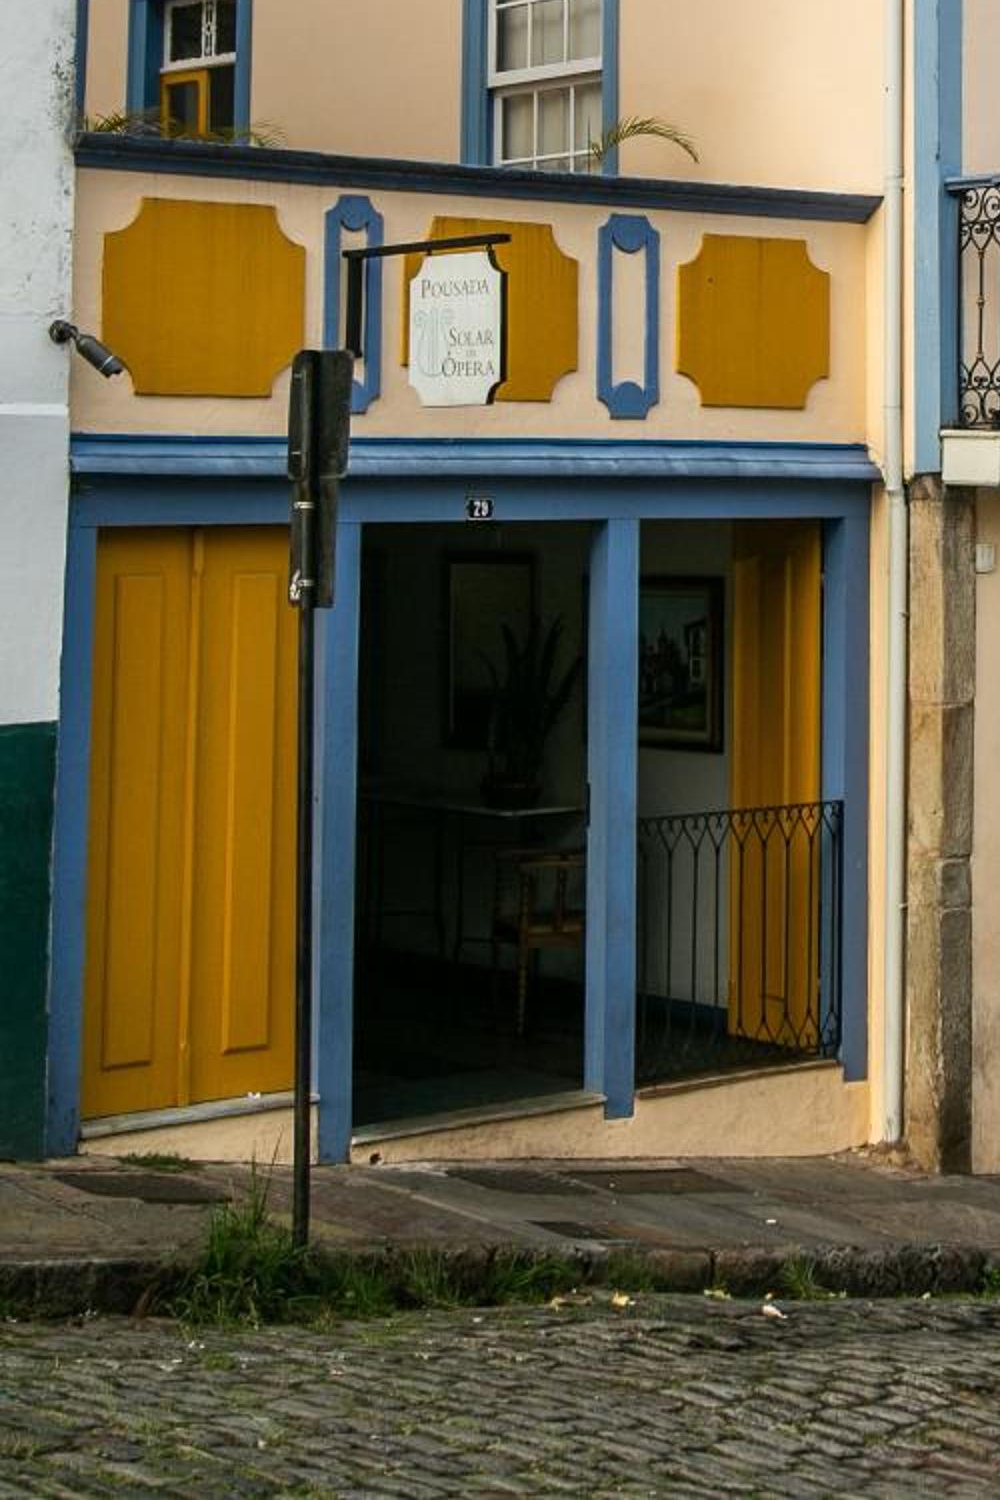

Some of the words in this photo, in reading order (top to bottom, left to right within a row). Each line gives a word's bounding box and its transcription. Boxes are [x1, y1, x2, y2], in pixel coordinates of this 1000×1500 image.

[420, 278, 490, 299] POUSADA
[449, 326, 494, 348] SOLAR
[441, 351, 495, 378] ÓPERA
